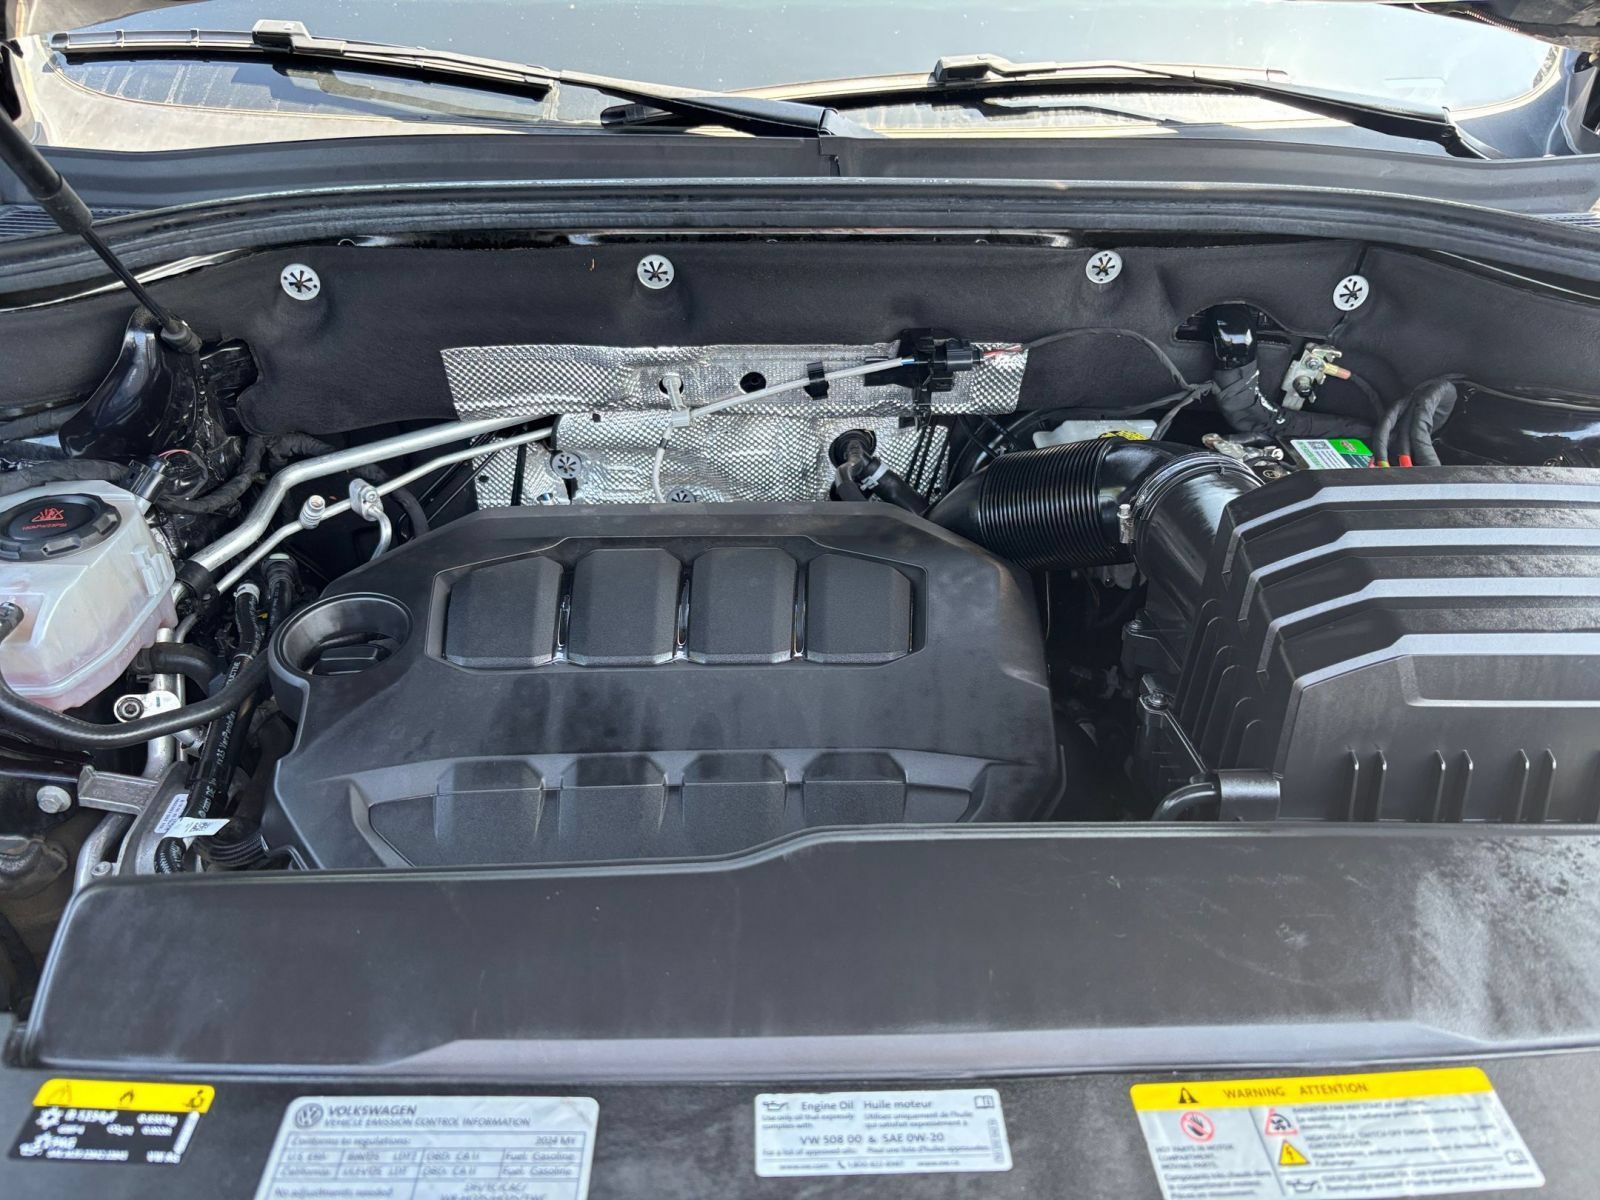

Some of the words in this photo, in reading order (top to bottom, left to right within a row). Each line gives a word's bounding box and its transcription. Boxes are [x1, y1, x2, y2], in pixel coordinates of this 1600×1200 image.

[1223, 1086, 1286, 1099] WARNING
[1300, 1082, 1369, 1096] ATTENTION
[328, 1104, 418, 1116] VOLKSWAGEN
[801, 1101, 837, 1112] Engine
[839, 1100, 854, 1110] Oil
[864, 1100, 891, 1109] Huile
[894, 1100, 933, 1108] moteur
[415, 1117, 459, 1127] CONTROL
[462, 1117, 531, 1127] INFORMATION
[799, 1135, 819, 1144] VW
[823, 1135, 844, 1144] 508
[847, 1134, 862, 1143] 00
[882, 1133, 903, 1143] SAE
[906, 1132, 945, 1142] 0W-20
[532, 1150, 576, 1161] Gasoline
[530, 1165, 573, 1176] Gasoline
